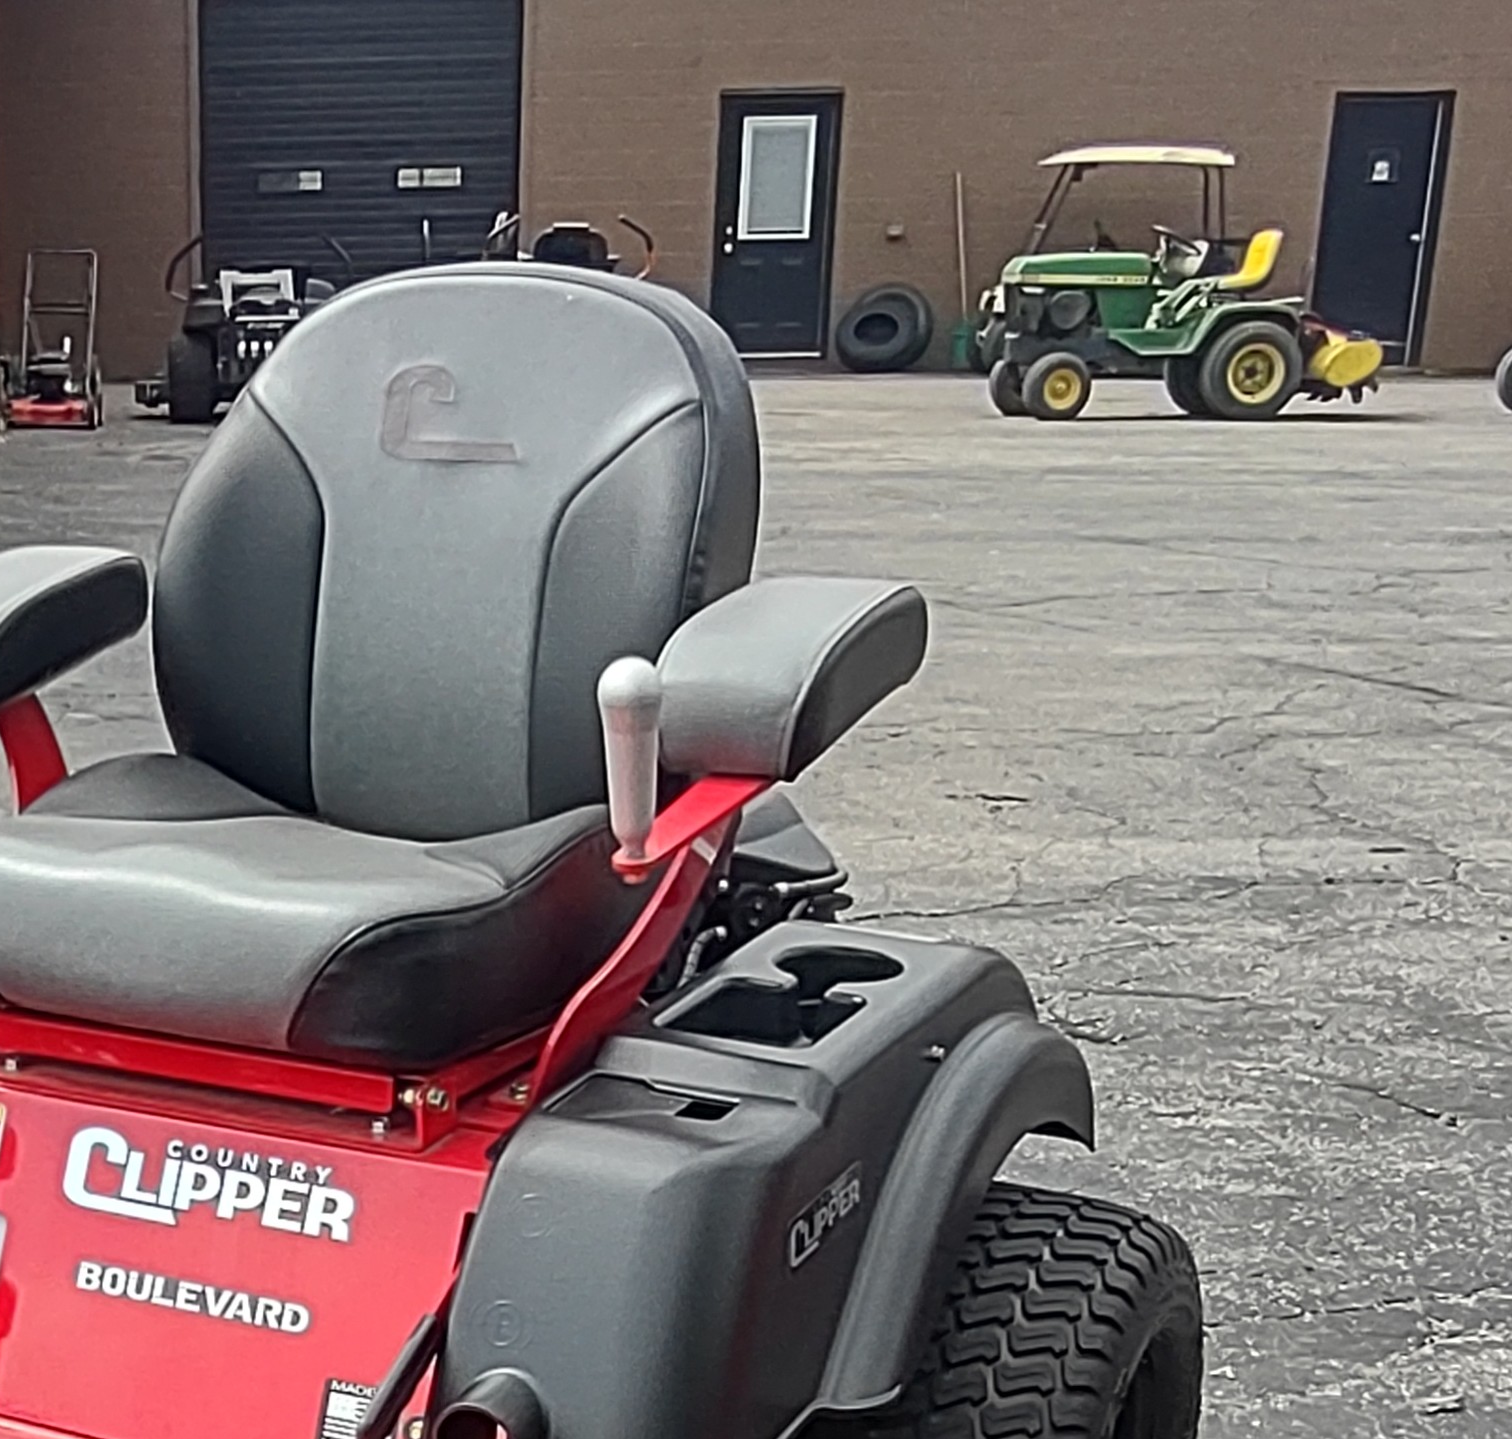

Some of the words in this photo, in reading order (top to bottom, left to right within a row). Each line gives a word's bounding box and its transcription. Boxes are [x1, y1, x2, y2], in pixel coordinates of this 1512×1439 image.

[63, 1127, 354, 1242] CLIPPER
[167, 1139, 332, 1185] COUNTRY
[790, 1179, 861, 1268] CLIPPER
[76, 1261, 310, 1333] BOULEVARD
